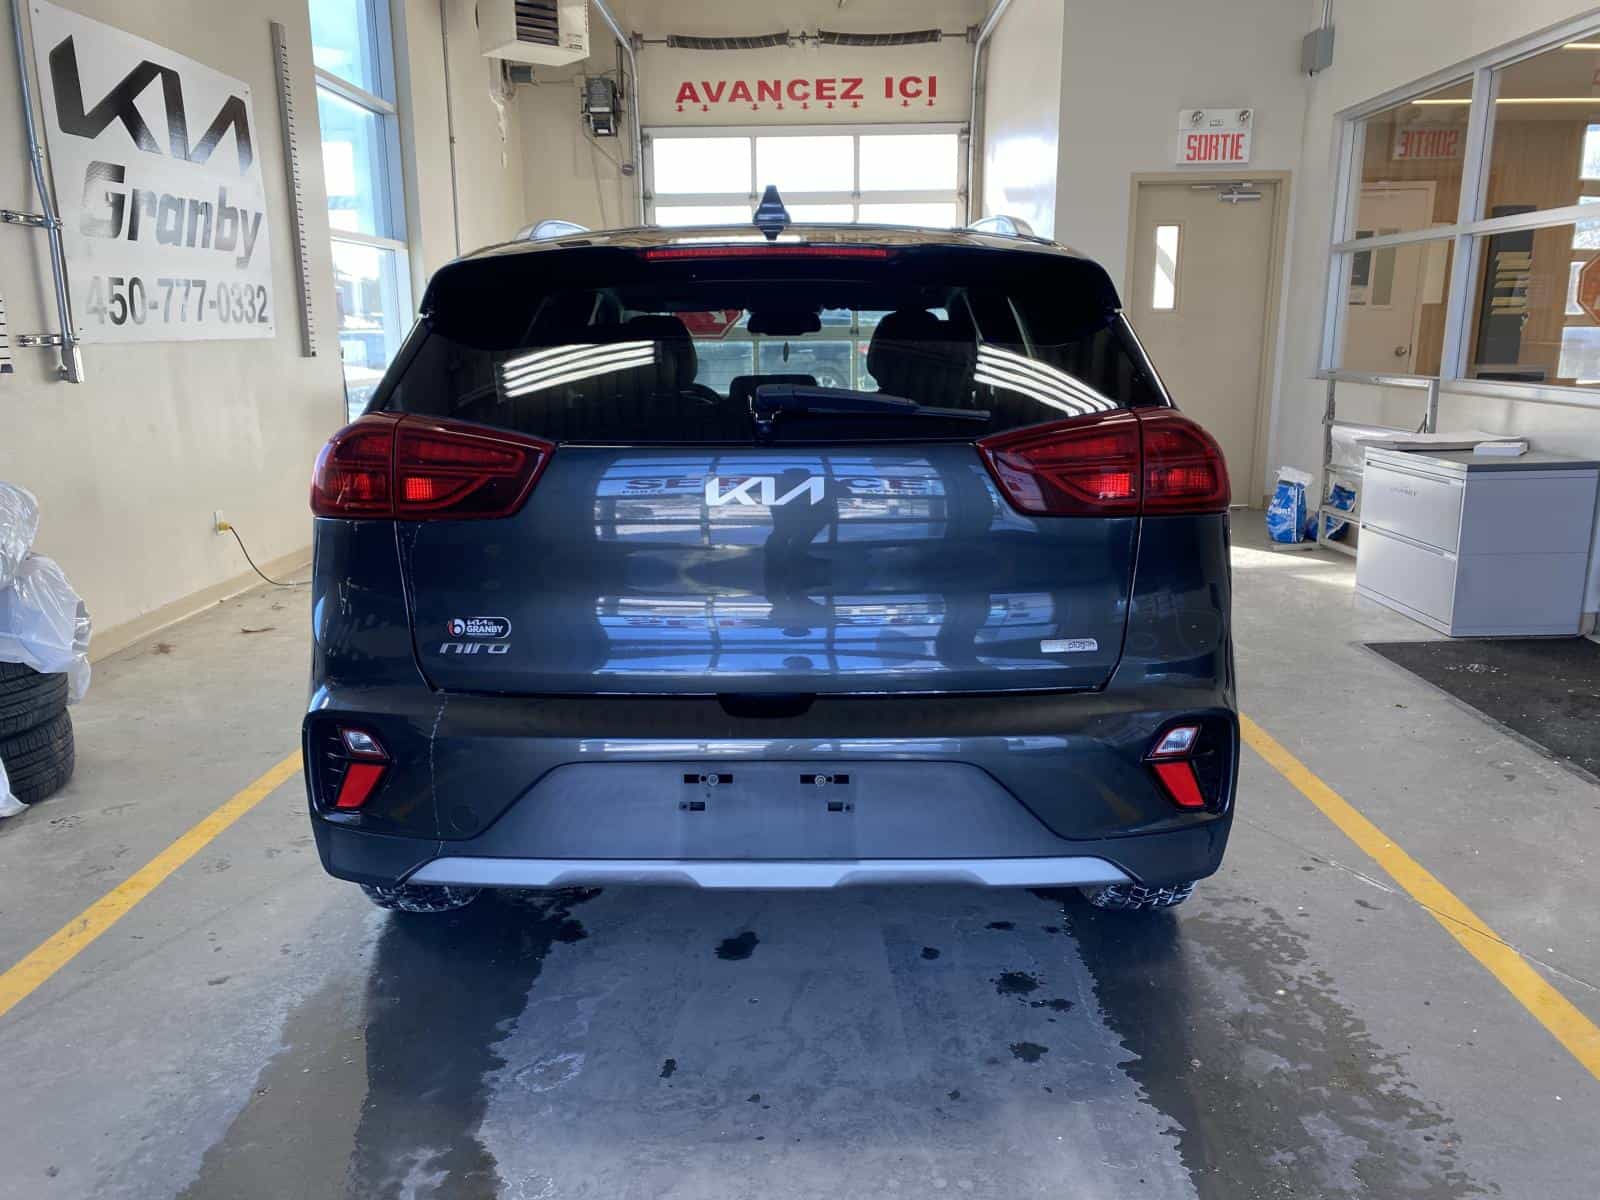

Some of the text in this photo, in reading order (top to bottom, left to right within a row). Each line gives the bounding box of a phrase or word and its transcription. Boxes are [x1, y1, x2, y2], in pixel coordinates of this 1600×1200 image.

[675, 76, 937, 103] AVANCEZ ICI
[1186, 133, 1245, 161] SORTIE
[80, 160, 263, 269] Granby
[85, 275, 269, 326] 450-777-0332
[705, 476, 825, 506] KIA
[466, 625, 504, 633] GRANBY
